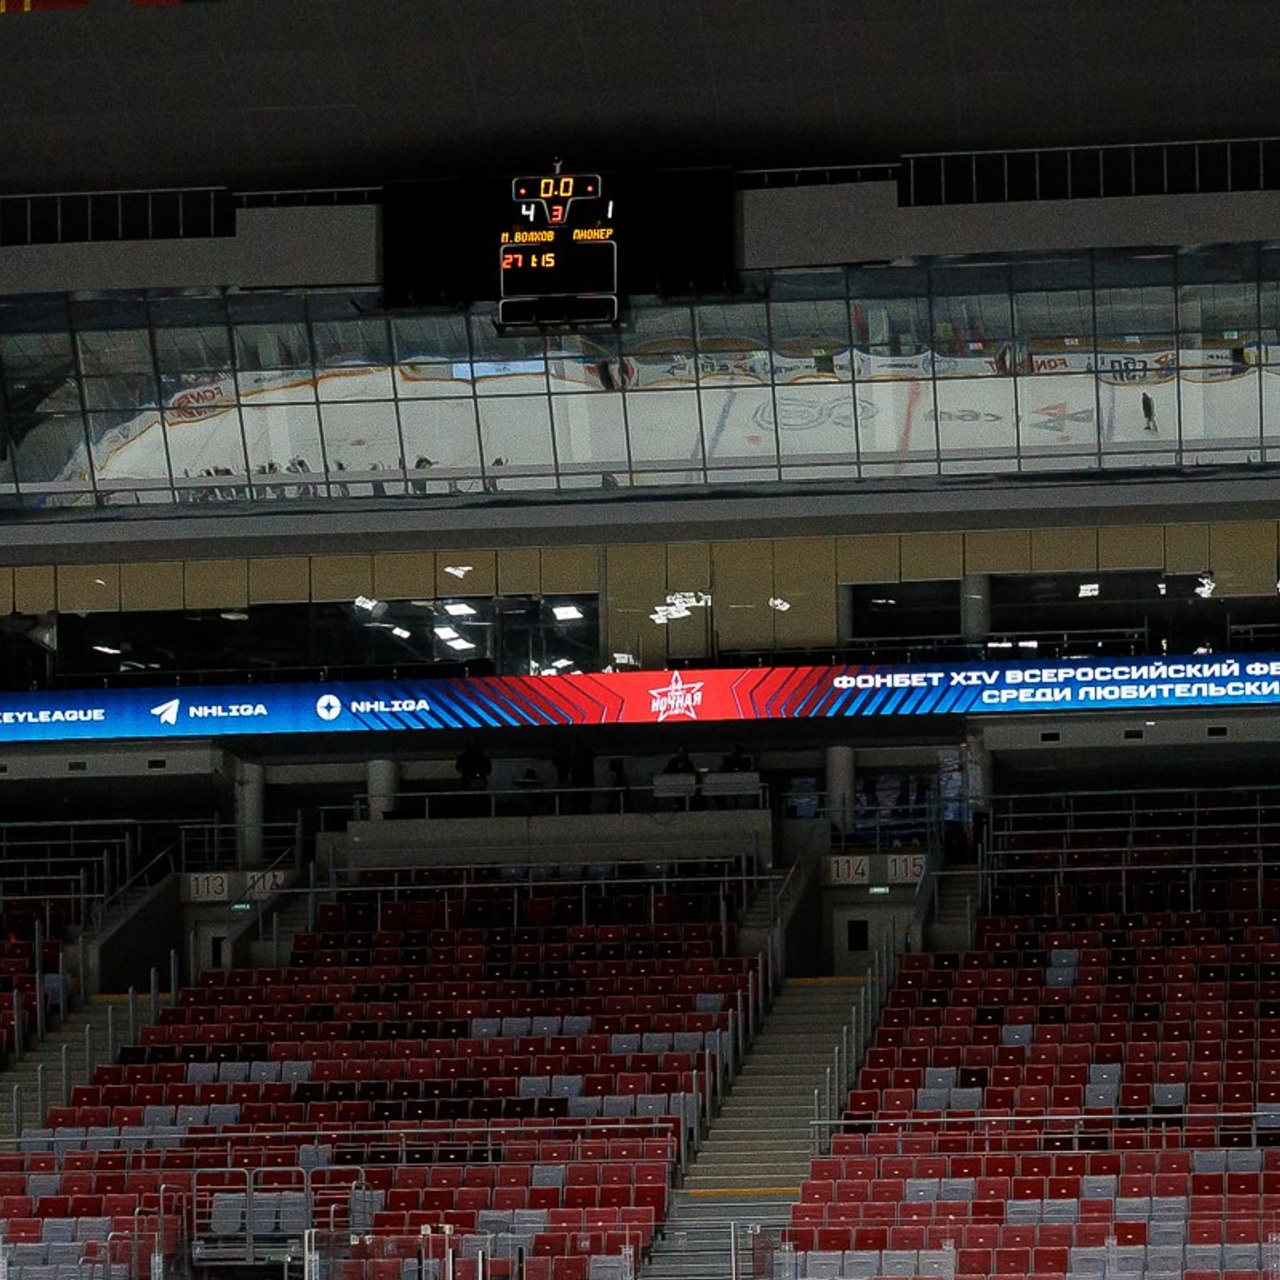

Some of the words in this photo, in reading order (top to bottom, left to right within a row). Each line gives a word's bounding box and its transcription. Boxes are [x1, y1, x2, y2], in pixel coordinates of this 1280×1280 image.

[540, 178, 574, 198] 0.0
[521, 203, 536, 222] 4
[552, 205, 564, 222] 3
[607, 200, 614, 219] 1
[502, 254, 523, 269] 27
[833, 672, 944, 689] ФОНБЕТ
[950, 670, 1000, 686] XIV
[1005, 659, 1240, 684] ВСЕРОССИЙСКИЙ
[350, 698, 431, 714] NHLIGA
[982, 687, 1072, 705] СРЕДИ
[0, 709, 105, 724] EYLEAGUE
[188, 703, 269, 719] NHLIGA
[832, 858, 866, 879] 114
[889, 857, 924, 878] 115
[190, 874, 227, 896] 113
